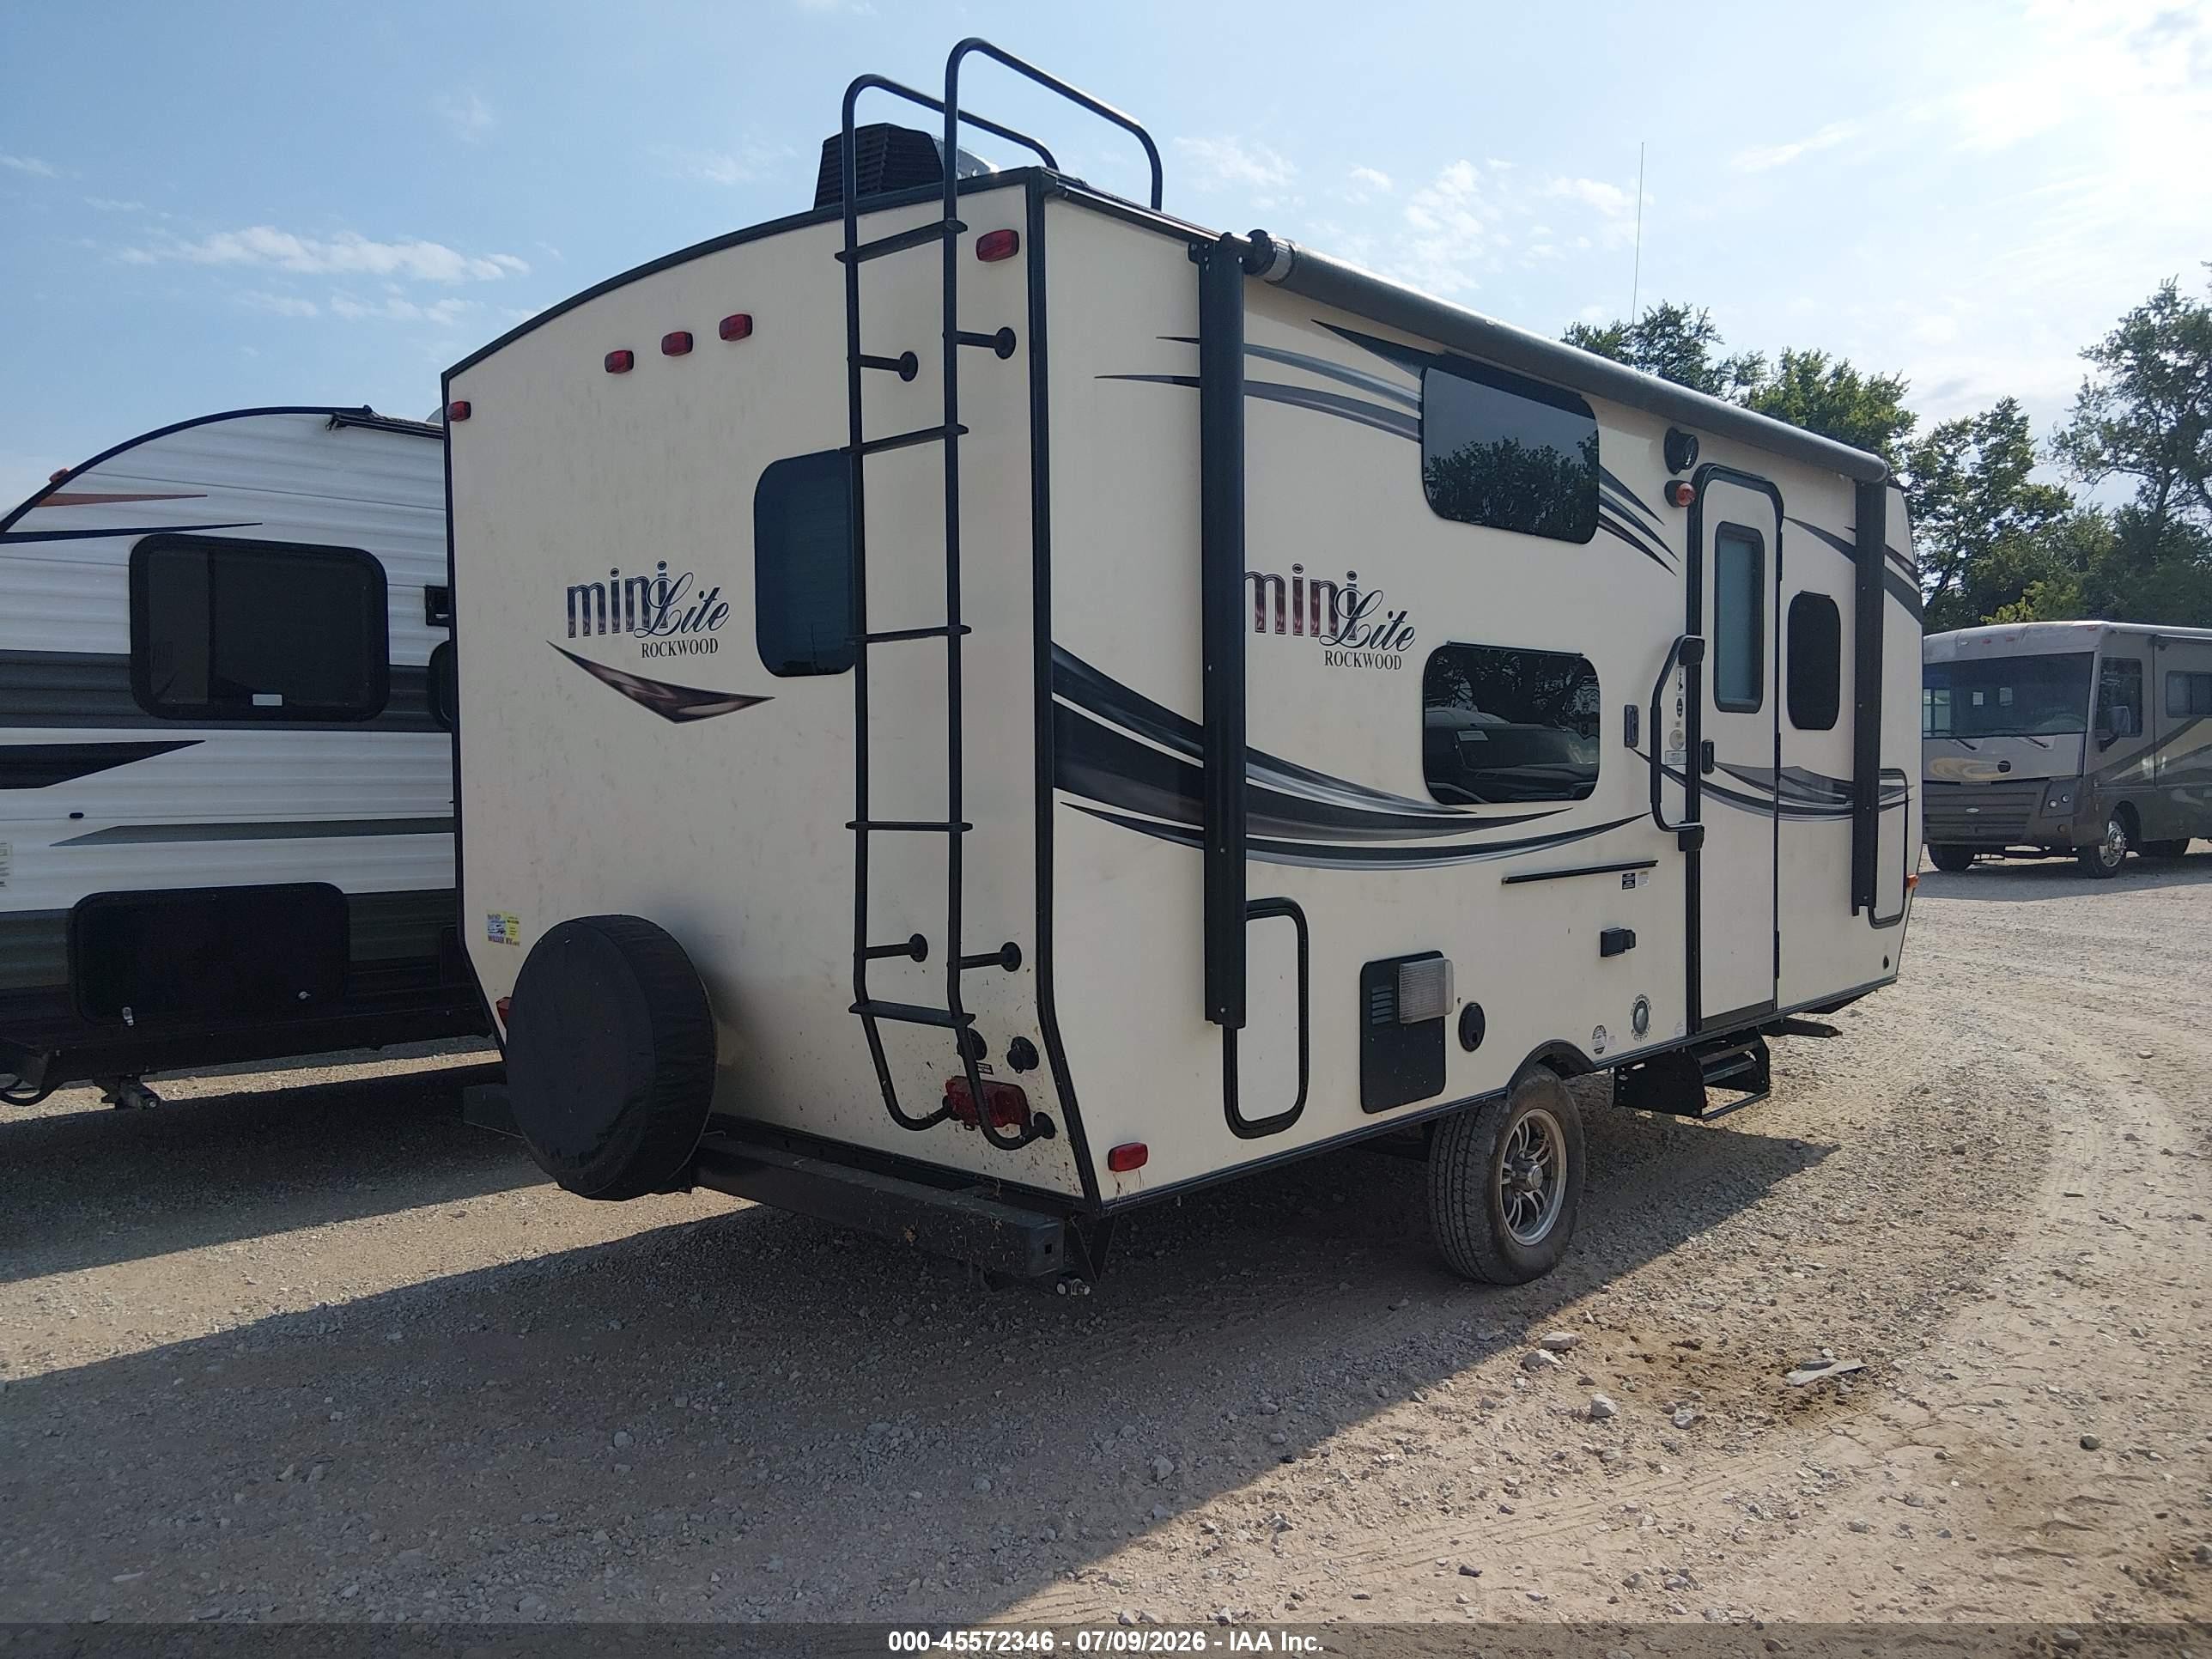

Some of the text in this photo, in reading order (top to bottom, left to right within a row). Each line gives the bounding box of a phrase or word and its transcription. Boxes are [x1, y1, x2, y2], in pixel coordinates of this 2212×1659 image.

[567, 560, 730, 639] mini Lite
[1243, 562, 1416, 653] mini Lite
[641, 637, 719, 659] ROCKWOOD
[1324, 650, 1402, 671] ROCKWOOD
